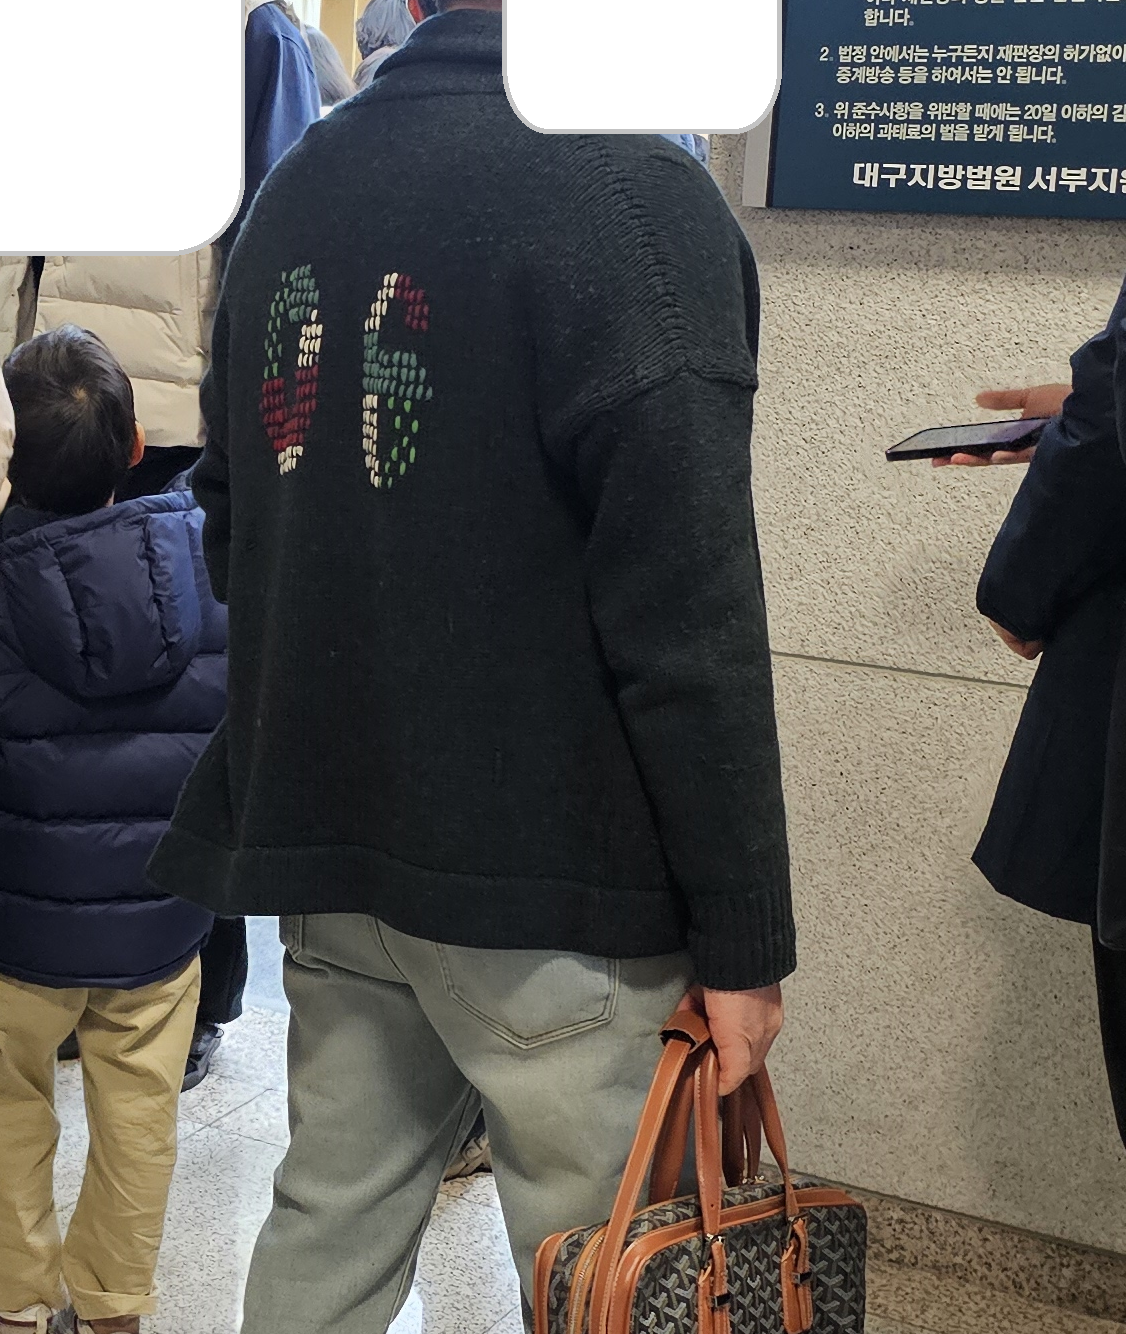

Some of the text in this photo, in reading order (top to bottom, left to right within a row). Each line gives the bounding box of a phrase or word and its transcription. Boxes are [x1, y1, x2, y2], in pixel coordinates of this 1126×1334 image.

[864, 9, 913, 26] 합니다.
[839, 45, 866, 63] 법정
[870, 45, 929, 62] 안에서는
[932, 45, 993, 62] 누구든지
[996, 44, 1060, 62] 재판장의
[1064, 44, 1126, 62] 허가없이
[836, 66, 1066, 84] 중계방송 등을 하여서는 안 됩니다.
[834, 102, 849, 119] 위
[852, 102, 924, 120] 준수사항을
[927, 103, 972, 120] 위반할
[975, 103, 1021, 120] 때에는
[1024, 104, 1057, 121] 20일
[1061, 104, 1108, 122] 이하의
[833, 123, 1056, 143] 이하의 과태료의 벌을 받게 됩니다.
[853, 163, 1126, 193] 대구지방법원 서부지
